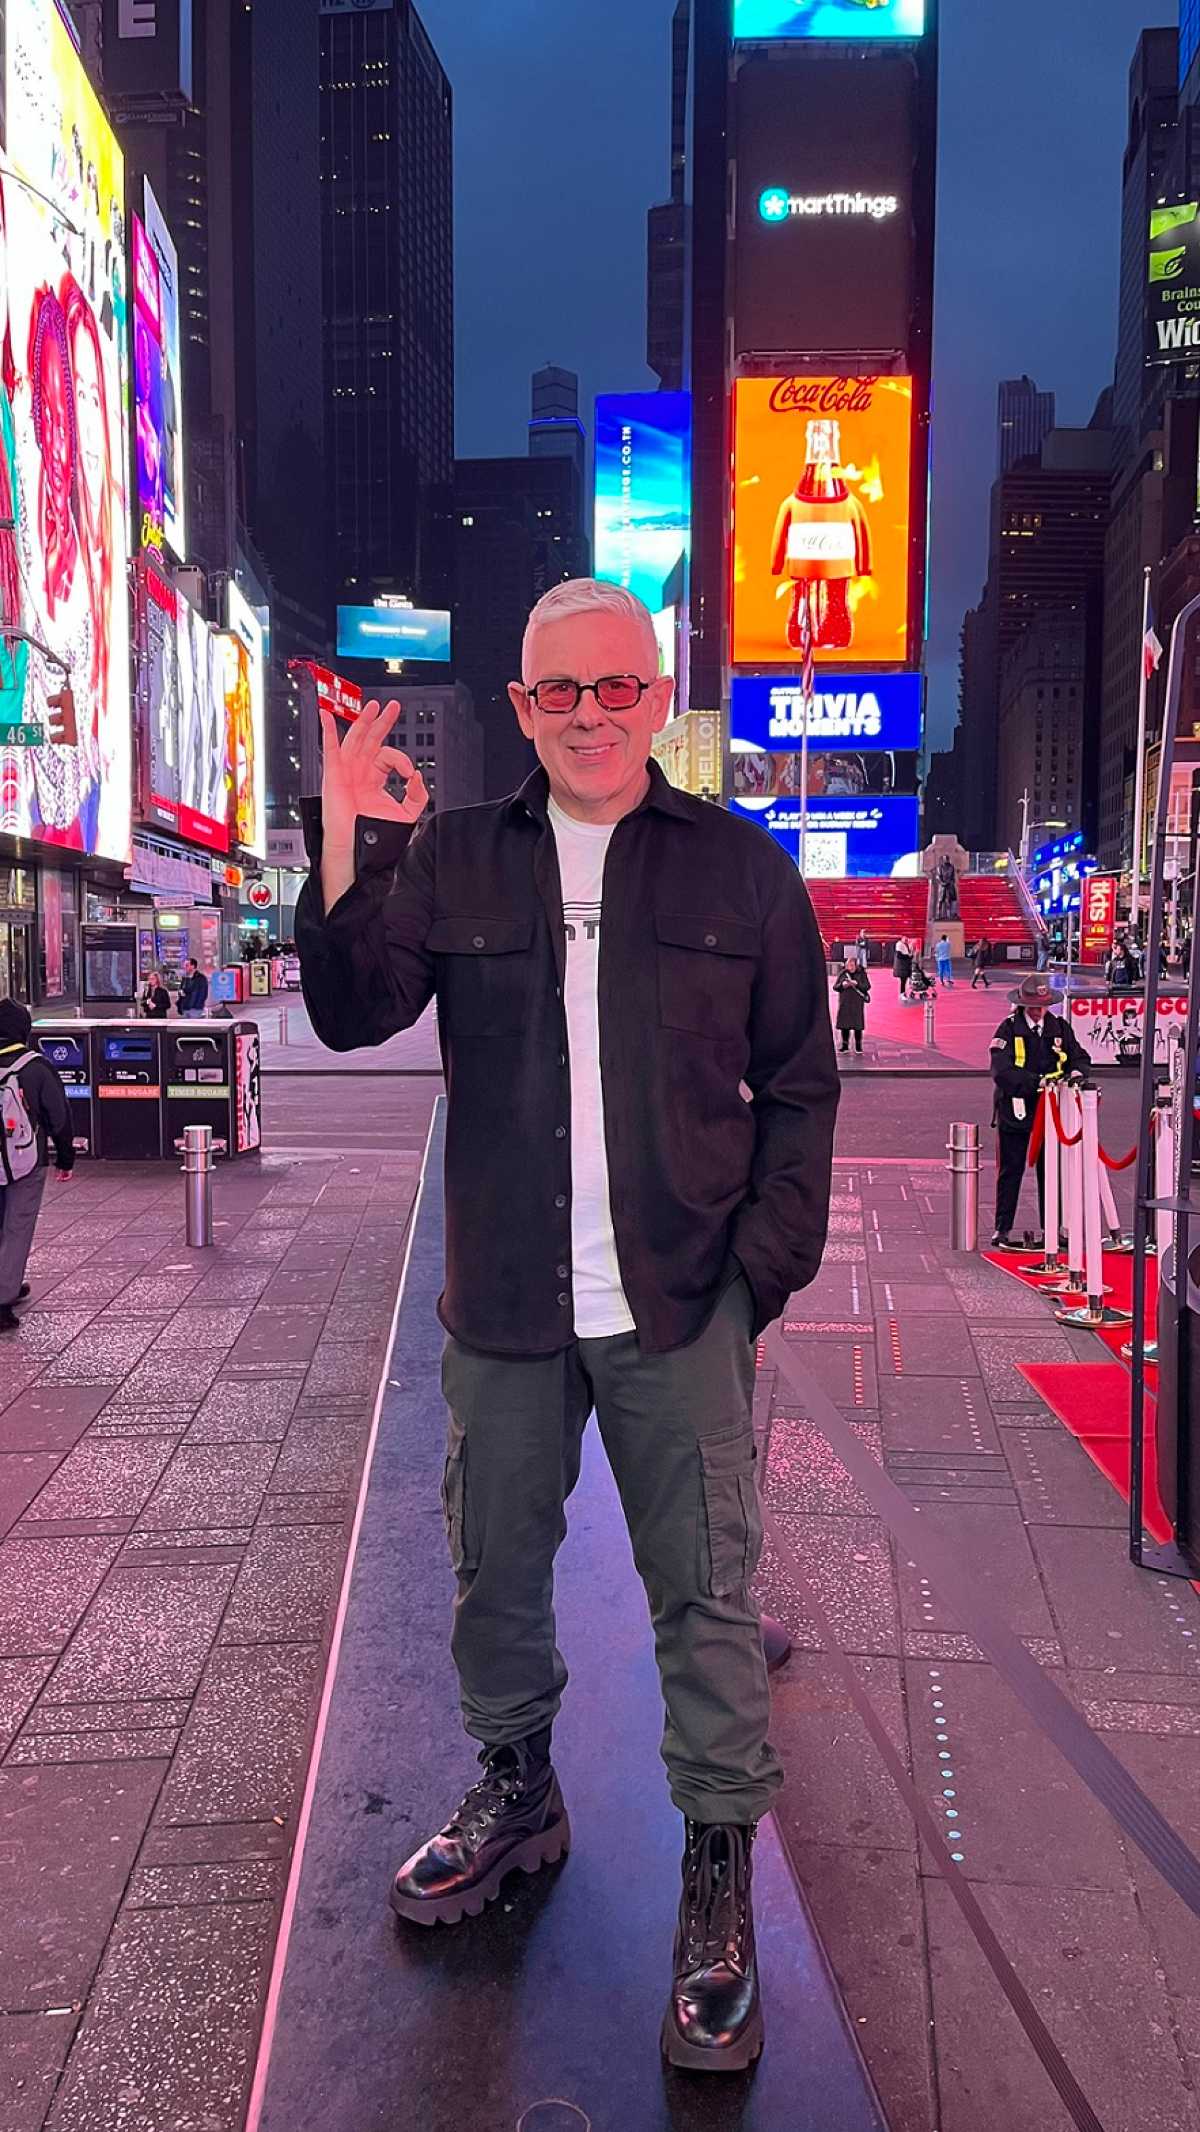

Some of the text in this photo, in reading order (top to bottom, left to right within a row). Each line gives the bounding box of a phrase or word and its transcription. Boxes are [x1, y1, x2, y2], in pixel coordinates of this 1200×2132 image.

[786, 192, 898, 218] martThings
[768, 376, 873, 413] Coca-Cola
[770, 693, 881, 719] TRIVIA
[7, 726, 26, 744] 46
[769, 717, 881, 737] MOMENTS
[1089, 881, 1111, 921] tkts
